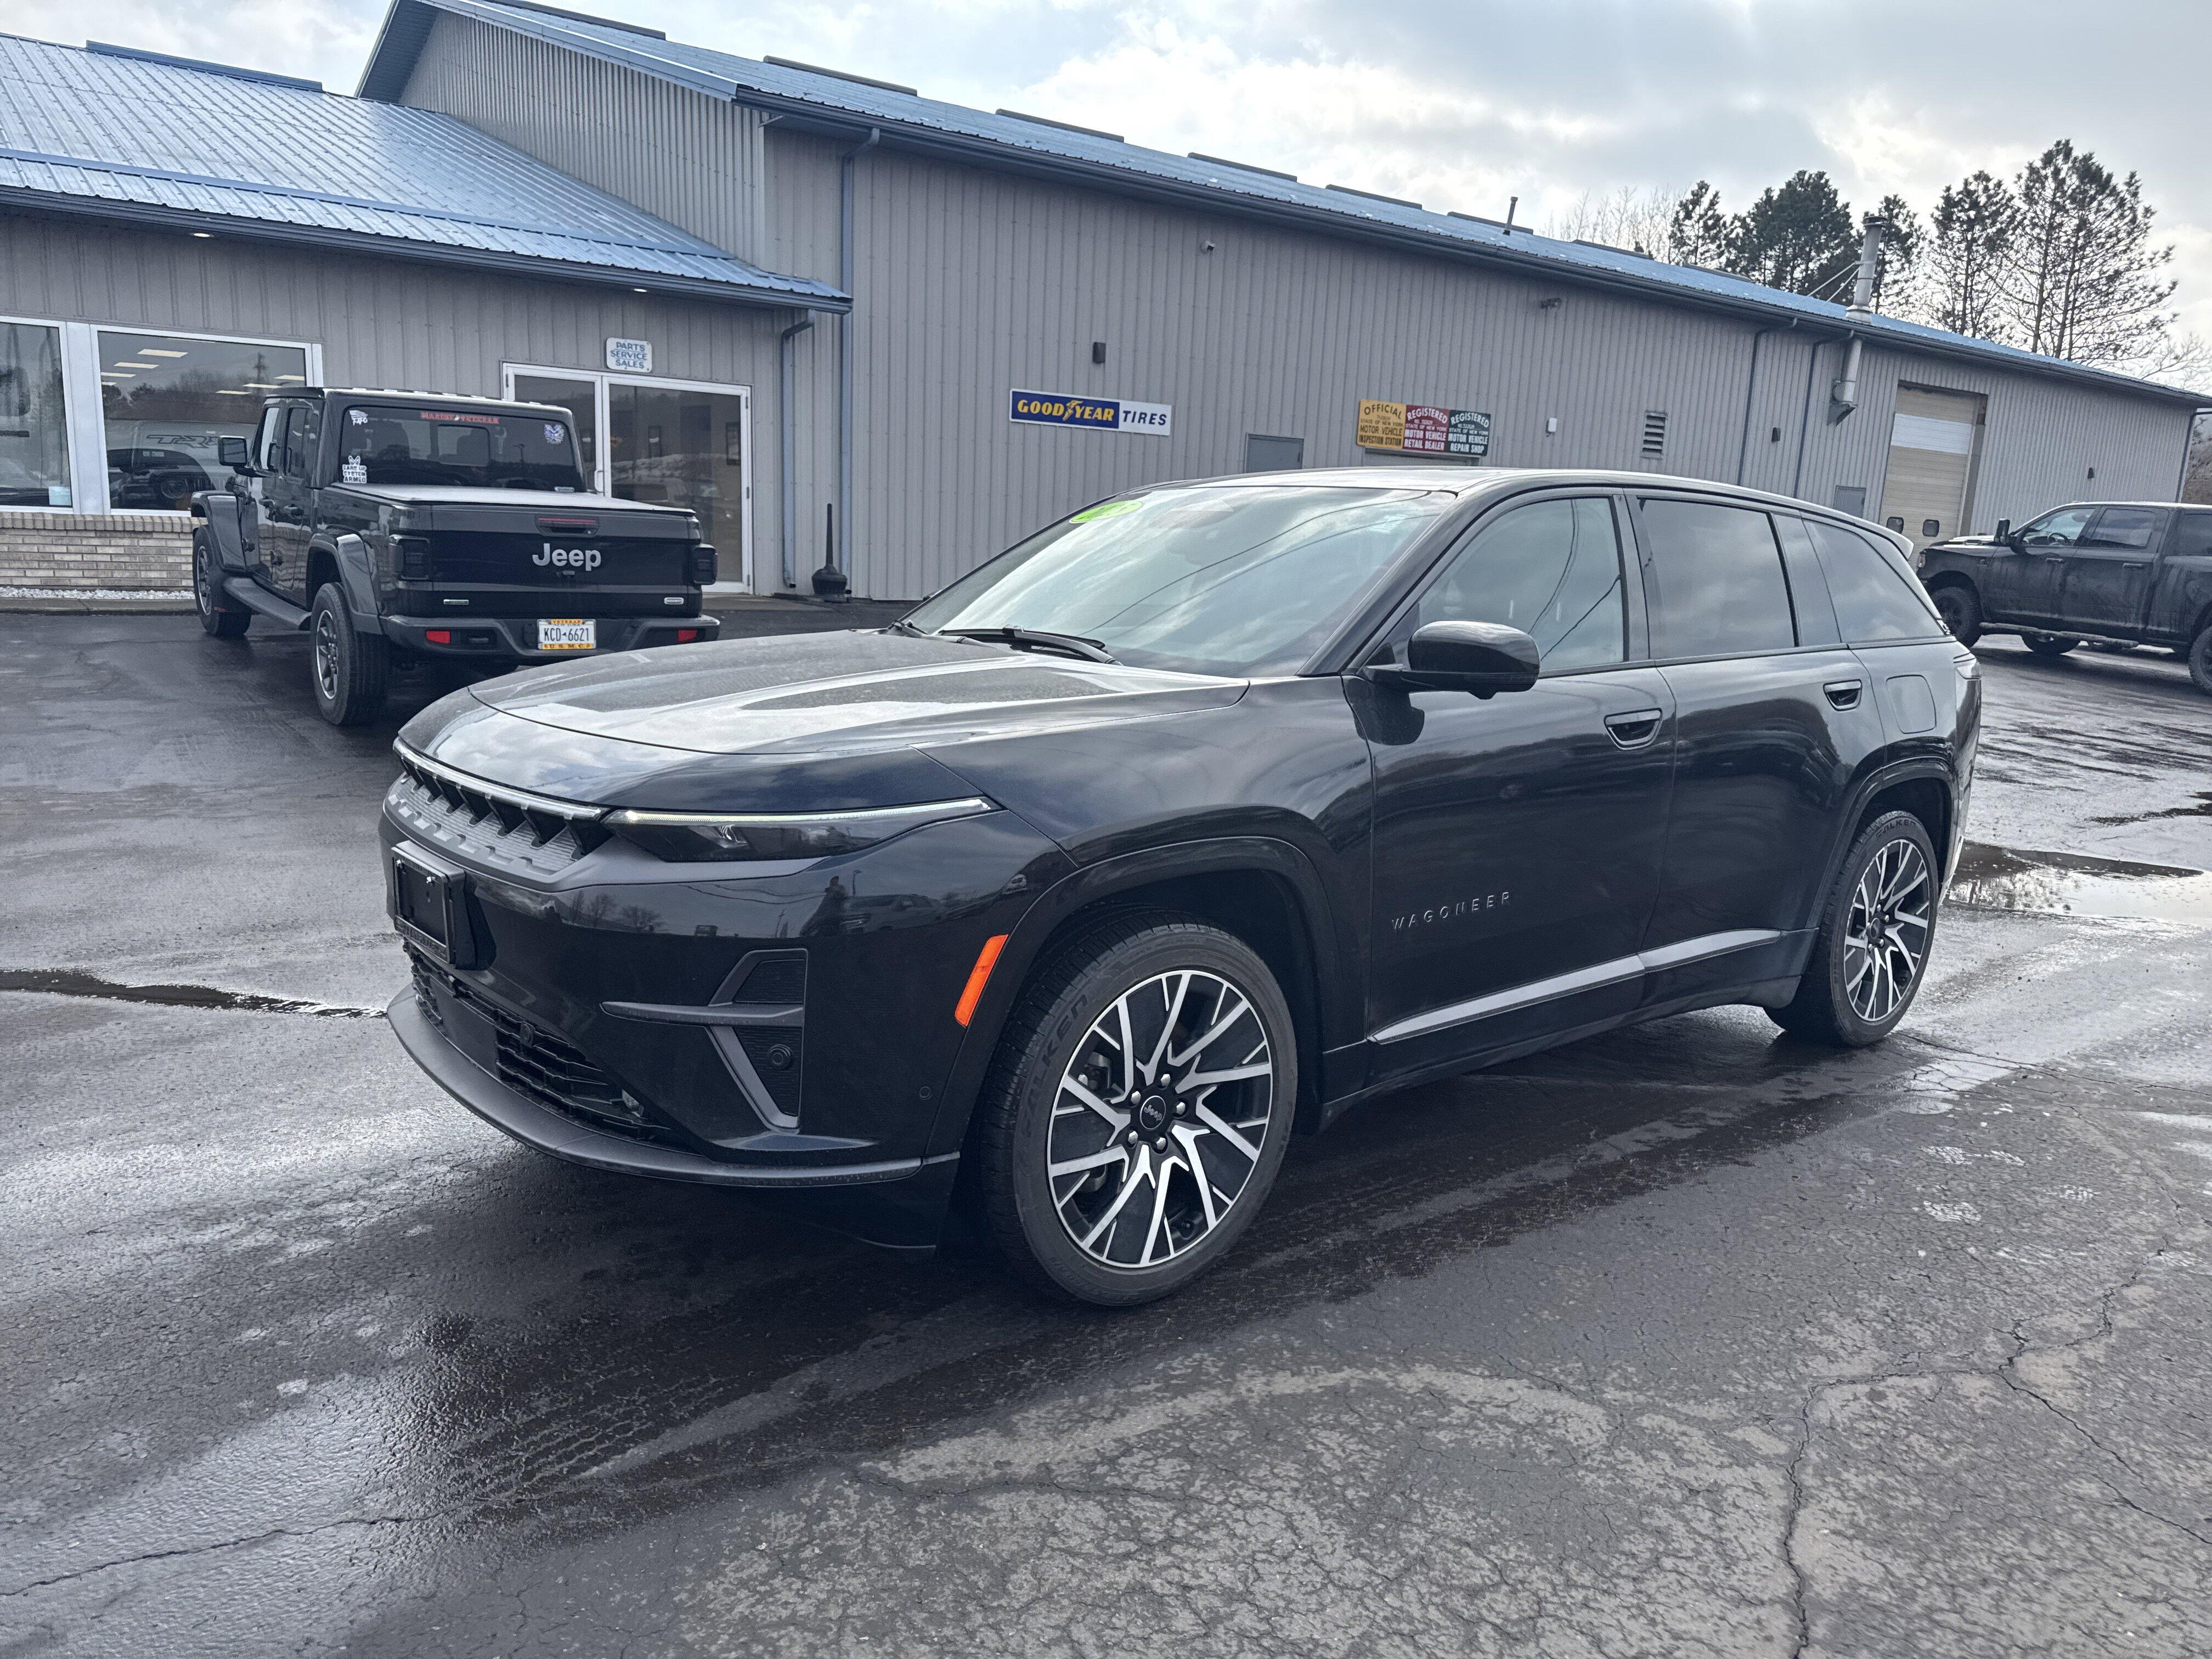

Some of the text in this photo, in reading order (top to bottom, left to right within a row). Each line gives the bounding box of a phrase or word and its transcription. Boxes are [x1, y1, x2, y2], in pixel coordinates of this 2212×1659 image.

[616, 342, 645, 352] PARTS
[611, 349, 647, 360] SERVICE
[616, 359, 644, 369] SALES
[1017, 399, 1168, 426] GOODYEAR TIRES
[1364, 404, 1402, 419] OFFICIAL
[1407, 408, 1448, 424] REGISTERED
[1451, 412, 1489, 428] REGISTERED
[1360, 425, 1403, 436] MOTOR VEHICLE
[1404, 429, 1447, 441] MOTOR VEHICLE
[1359, 435, 1402, 446] INSPECTION STATION
[1404, 439, 1445, 450] RETAIL DEALER
[1448, 433, 1488, 445] MOTOR VEHICLE
[1450, 443, 1485, 454] REPAIR SHOP
[532, 543, 601, 572] Jeep
[544, 628, 589, 641] KCD 6621
[1392, 891, 1510, 929] WAGONEER
[1144, 1104, 1163, 1122] Jeep
